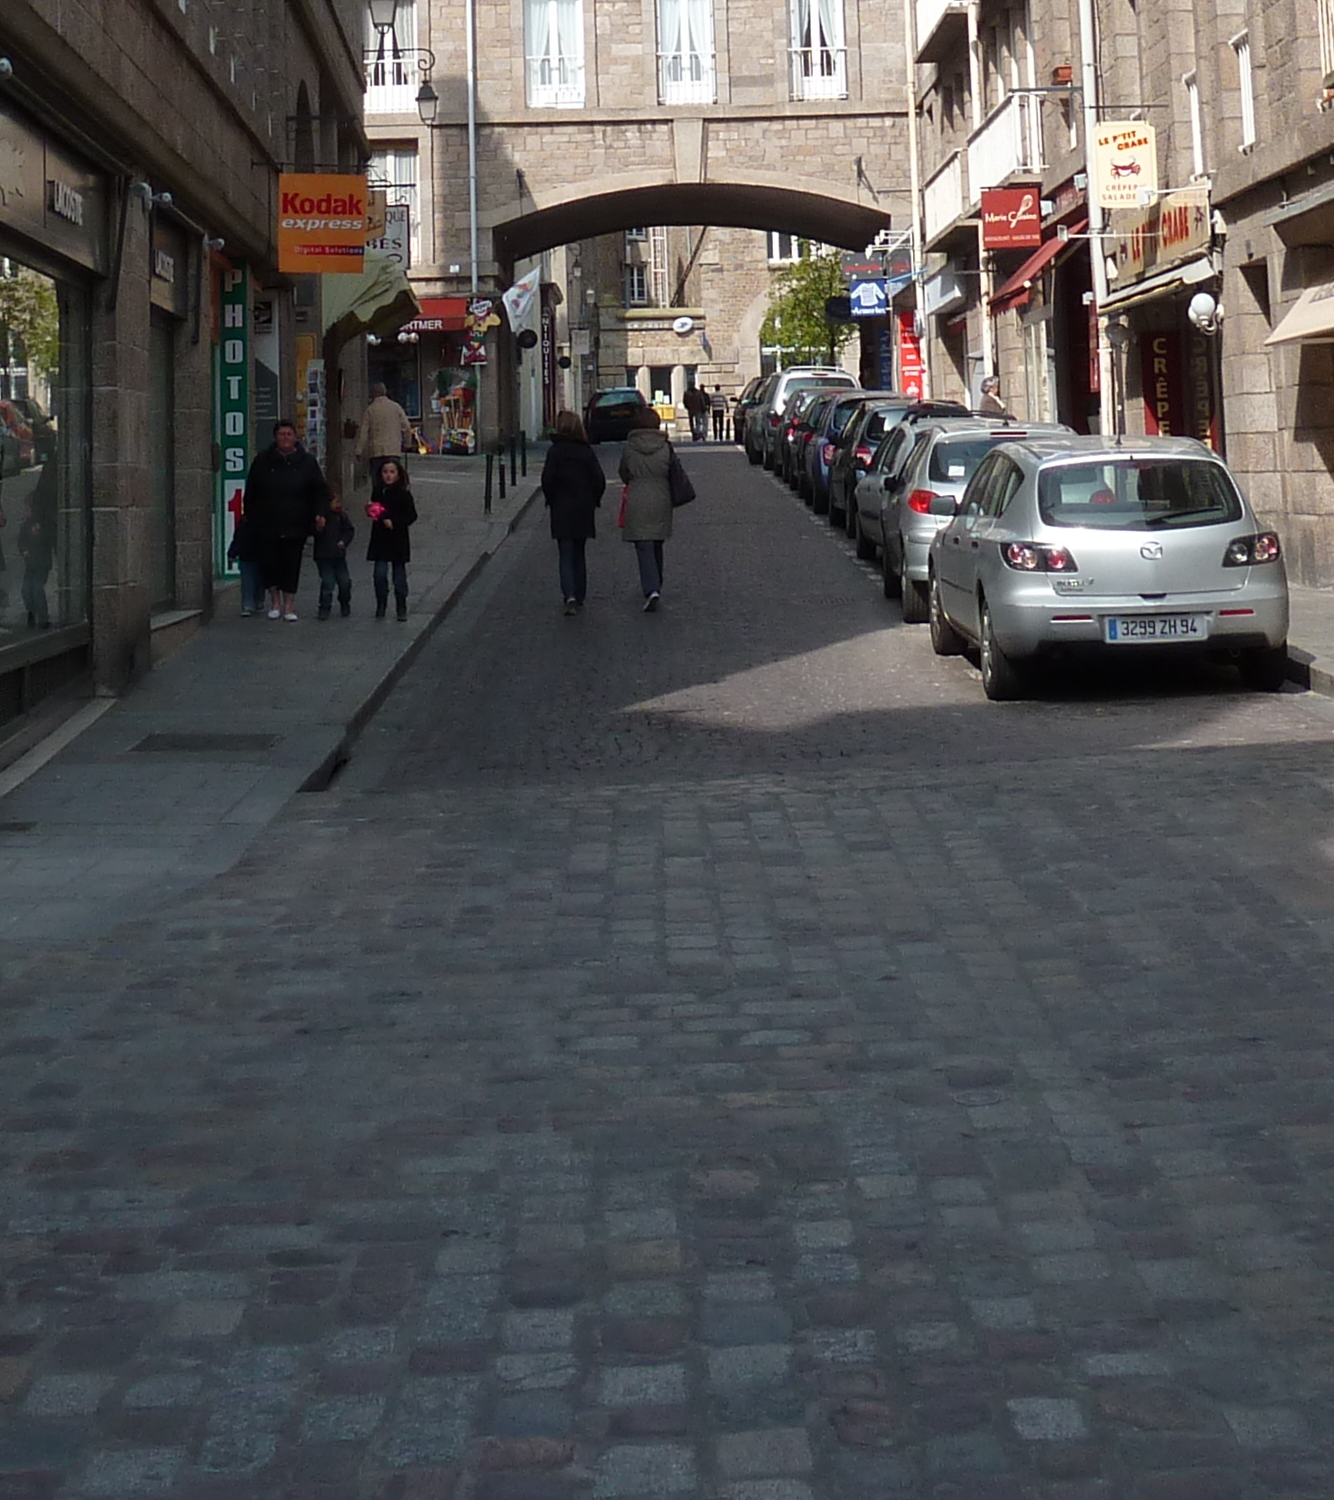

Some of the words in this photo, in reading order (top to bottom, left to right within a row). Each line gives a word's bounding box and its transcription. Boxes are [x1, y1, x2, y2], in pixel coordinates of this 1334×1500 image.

[1098, 137, 1110, 147] LE
[1117, 137, 1149, 151] CRABE
[282, 192, 364, 216] Kodak
[1102, 193, 1137, 201] SALADE
[281, 217, 363, 232] express
[324, 246, 364, 255] Solutions
[224, 269, 245, 472] PHOTOS
[1120, 619, 1157, 637] 3299
[1159, 619, 1178, 636] ZH
[1180, 618, 1198, 635] 94
